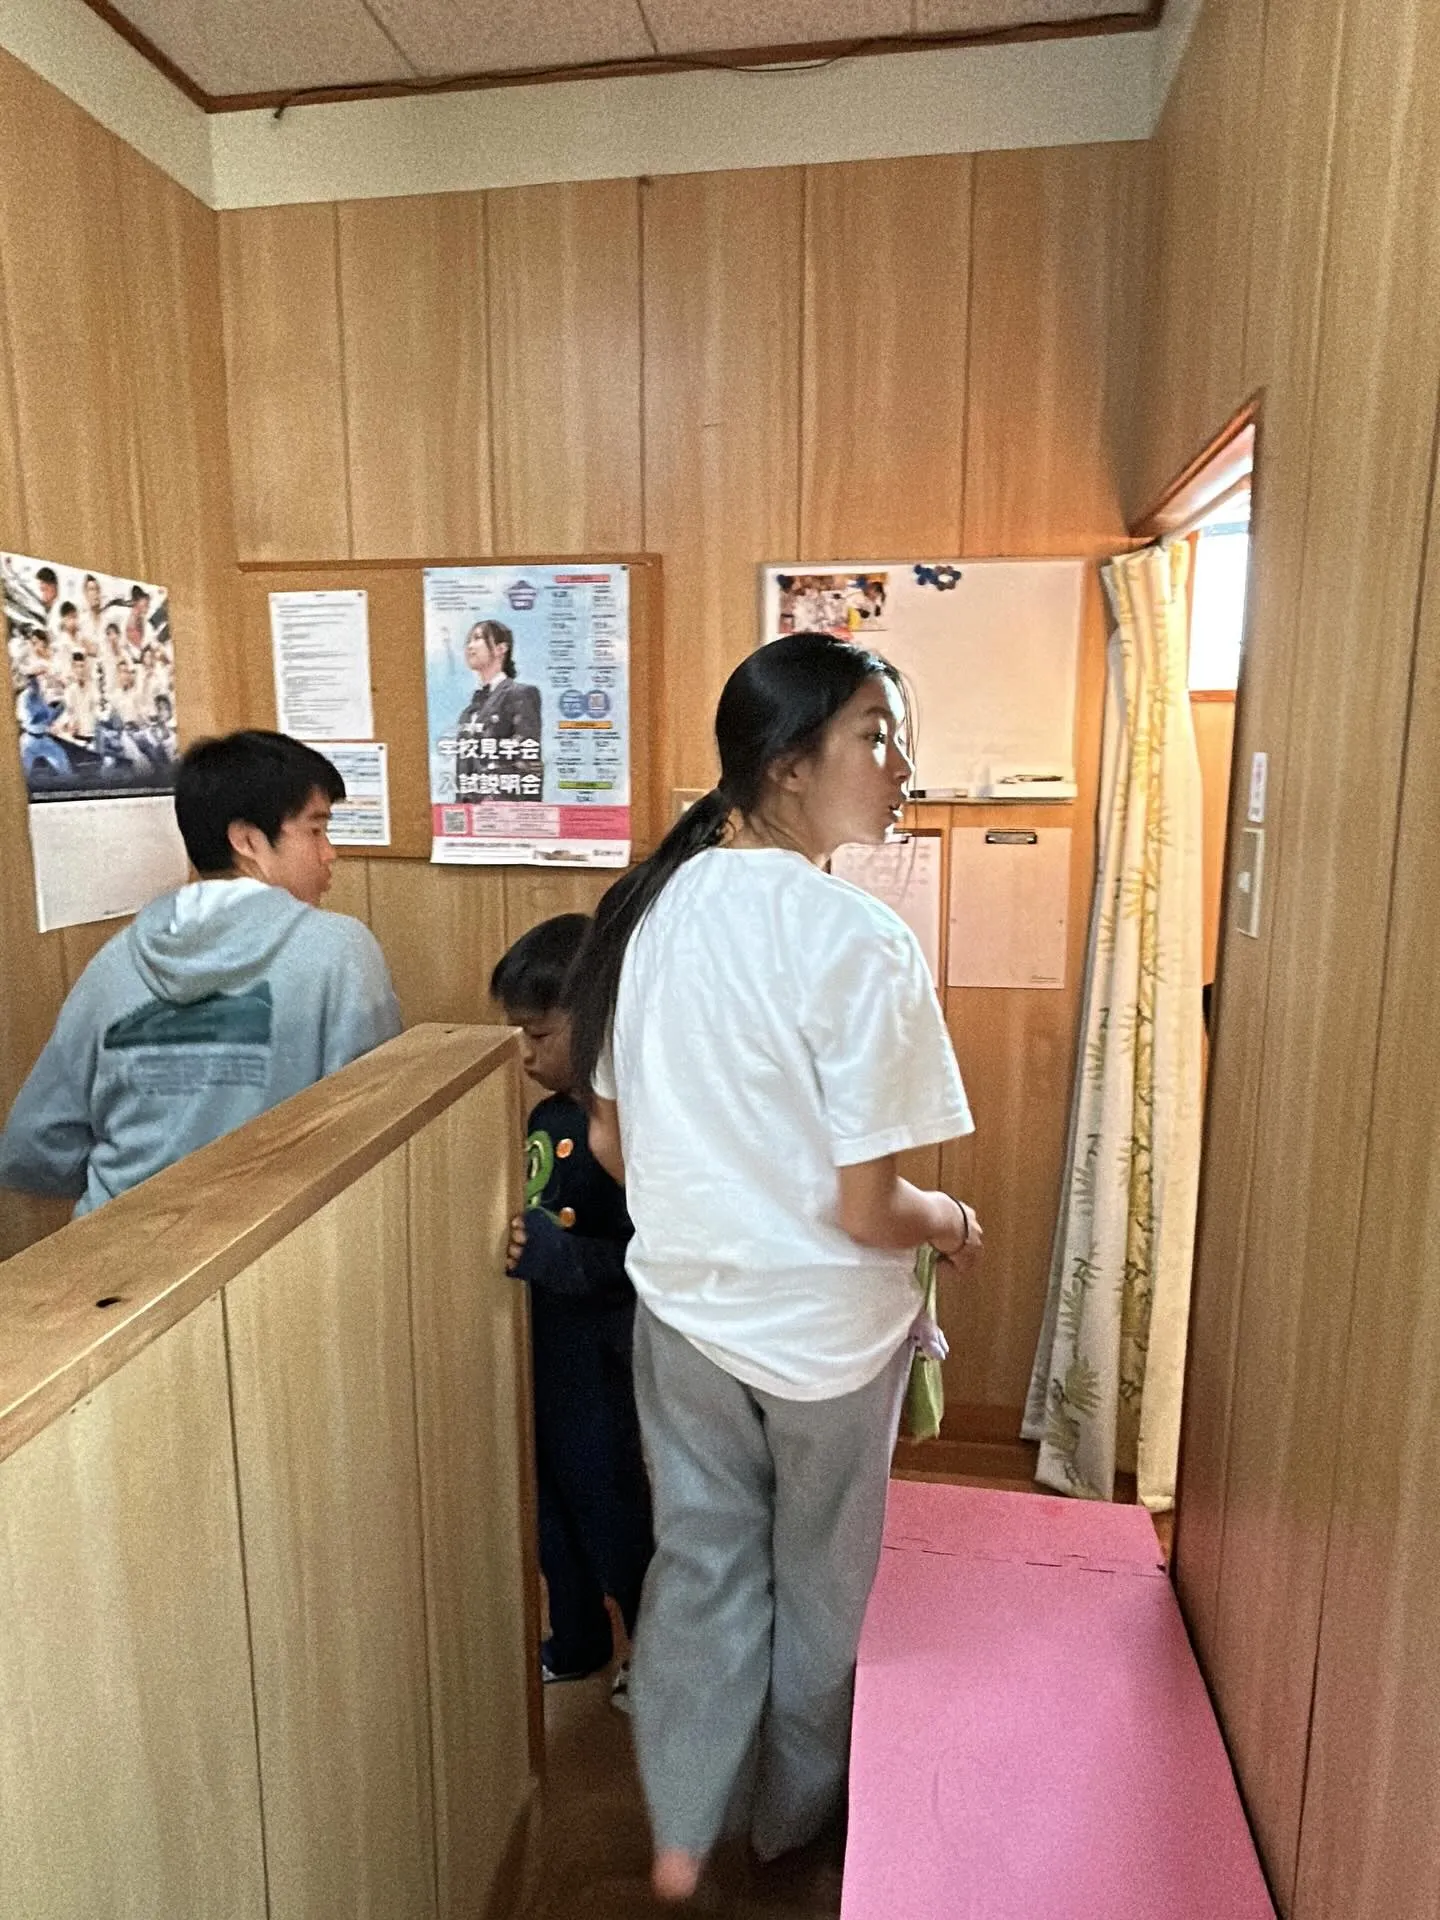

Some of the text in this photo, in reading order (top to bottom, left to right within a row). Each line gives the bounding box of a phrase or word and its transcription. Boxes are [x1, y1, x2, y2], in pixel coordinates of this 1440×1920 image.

[437, 737, 540, 760] 学校見学会
[438, 771, 541, 795] 入試説明会
